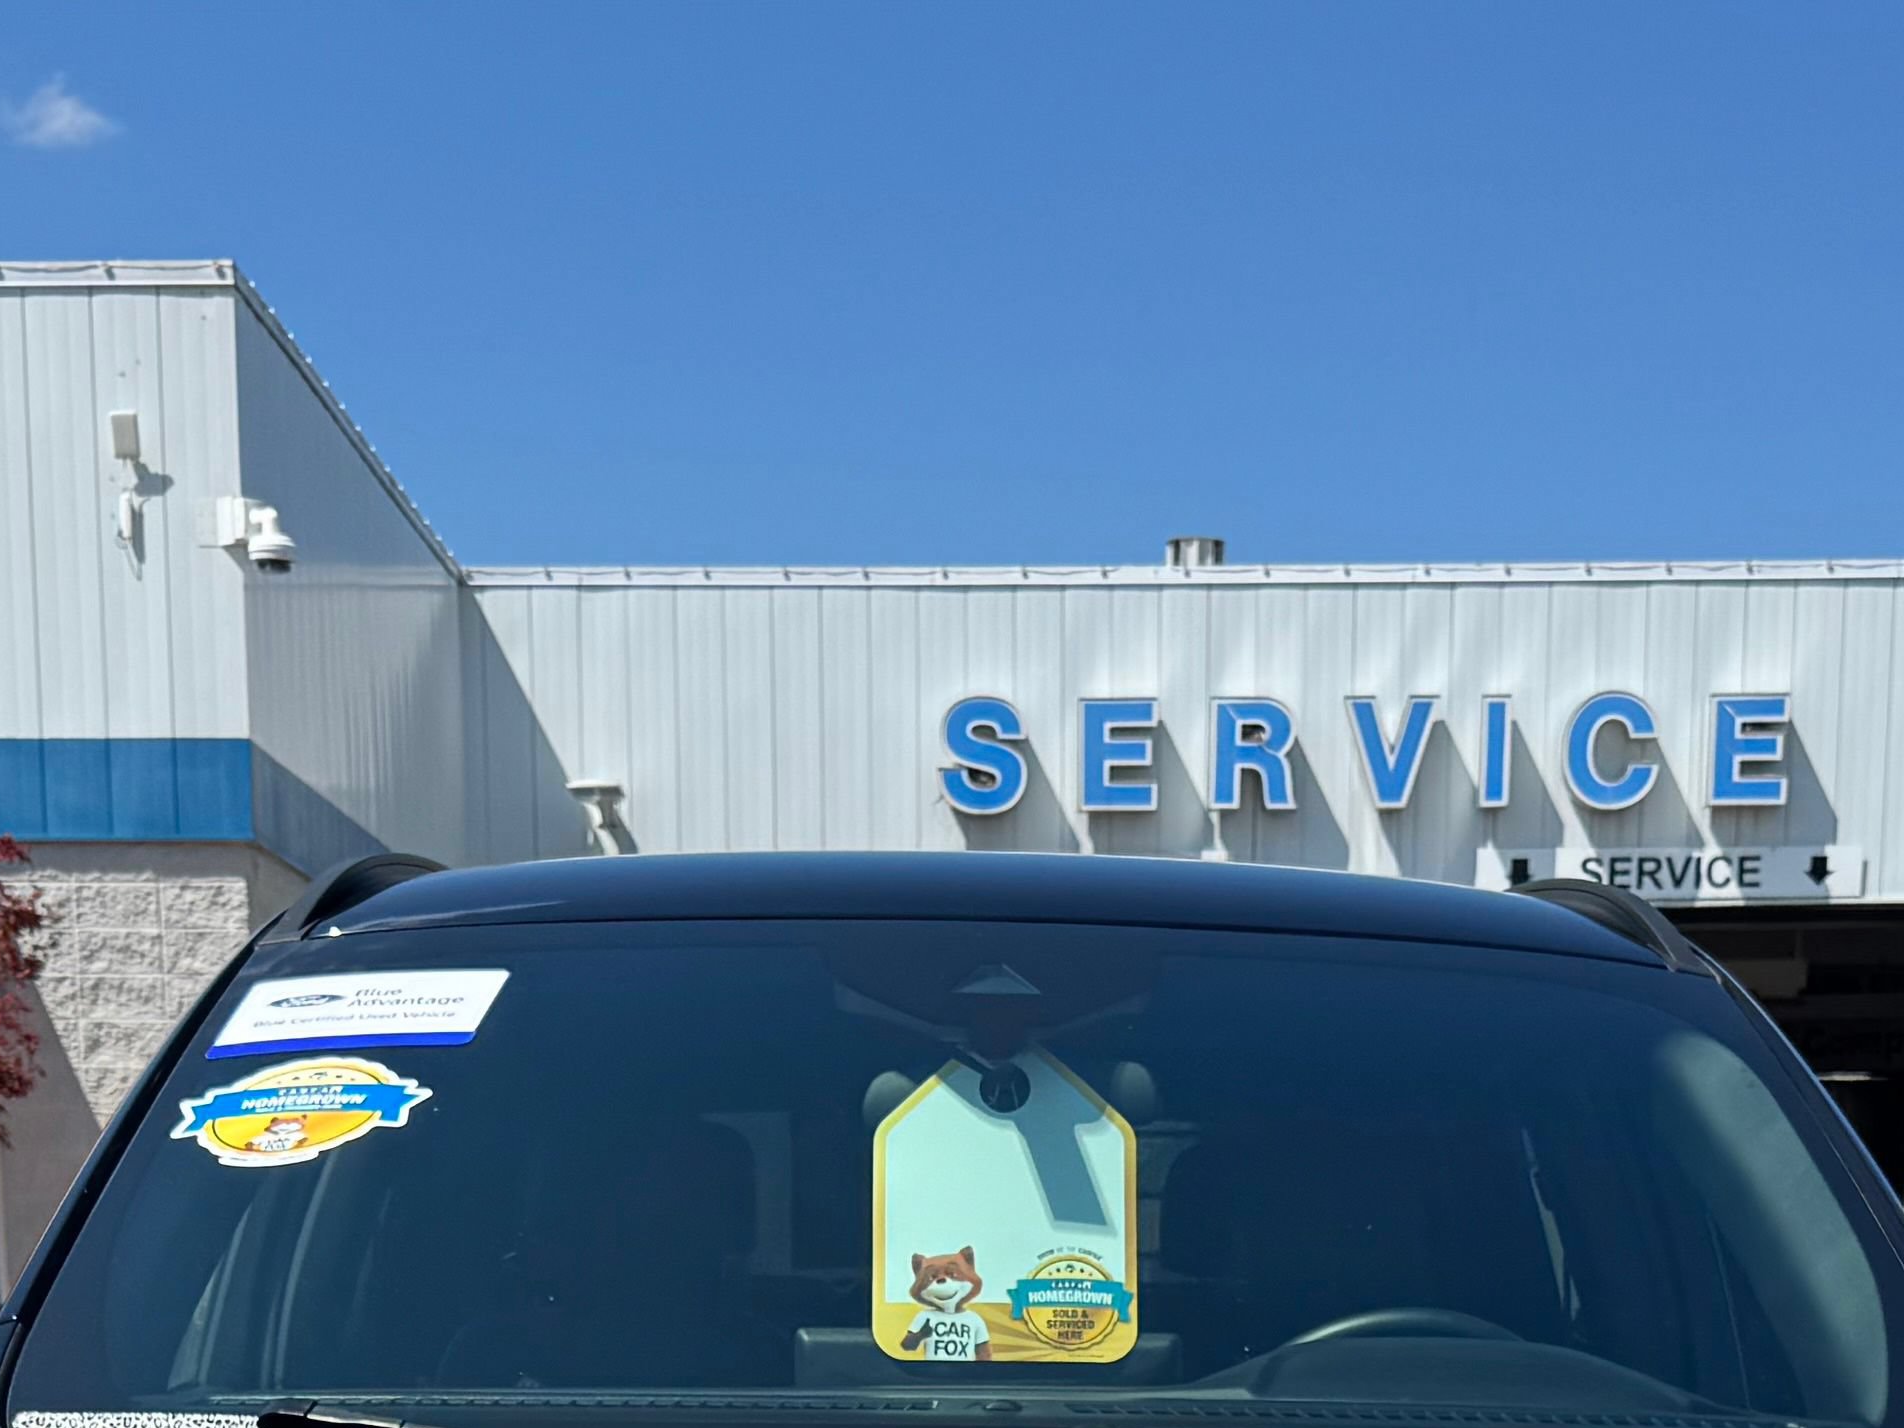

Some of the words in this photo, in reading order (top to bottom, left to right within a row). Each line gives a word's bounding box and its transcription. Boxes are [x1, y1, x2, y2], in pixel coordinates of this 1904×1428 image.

[938, 691, 1792, 813] SERVICE
[1581, 855, 1762, 889] SERVICE
[355, 987, 403, 997] Blue
[346, 995, 465, 1008] Advantage
[240, 1093, 369, 1111] HOMEGROWN
[1027, 1290, 1113, 1305] HOMEGROWN
[1052, 1309, 1079, 1319] SOLD
[934, 1321, 971, 1339] CAR
[1046, 1320, 1095, 1330] SERVICED
[1057, 1330, 1084, 1341] HERE
[934, 1339, 969, 1358] FOX
